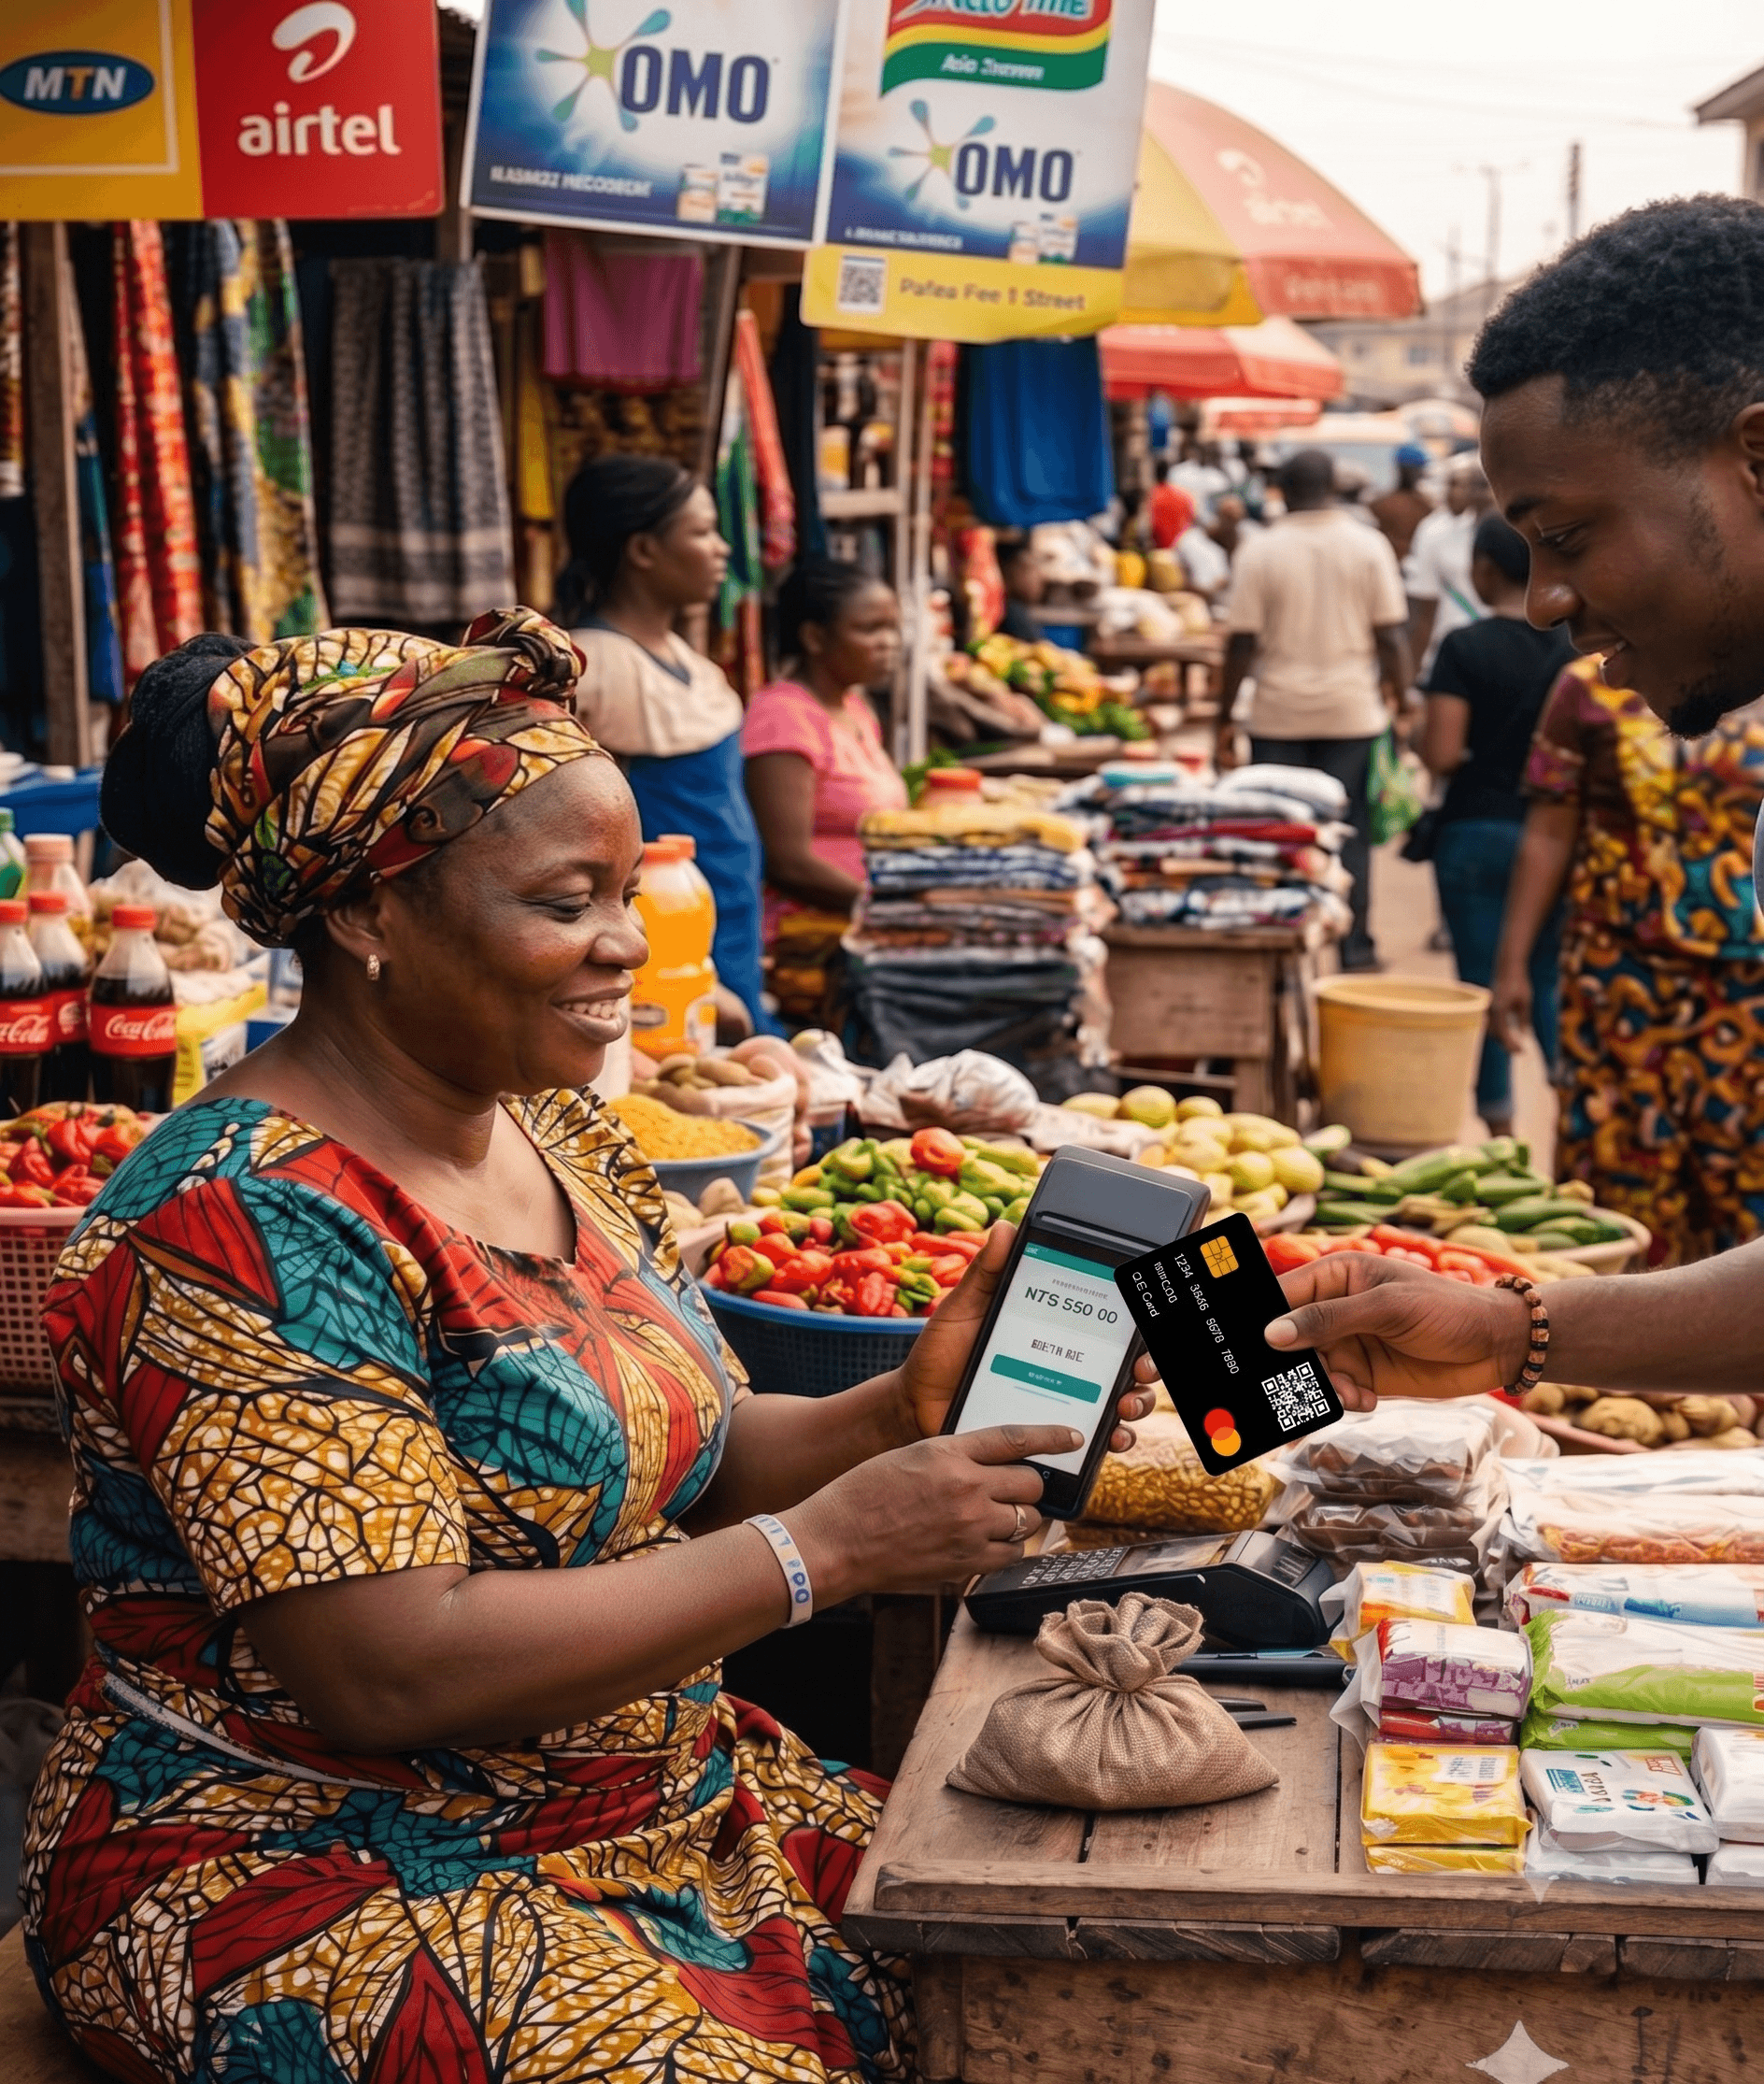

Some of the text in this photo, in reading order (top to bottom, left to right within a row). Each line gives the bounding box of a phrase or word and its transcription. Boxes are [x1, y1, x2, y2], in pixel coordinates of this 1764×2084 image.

[23, 66, 127, 101] MTN
[619, 44, 771, 125] OMO
[237, 100, 402, 156] airtel
[956, 141, 1074, 203] OMO
[1022, 287, 1087, 311] Street
[1174, 1252, 1194, 1278] 1234
[1024, 1286, 1060, 1307] NTS
[1061, 1297, 1094, 1317] 550
